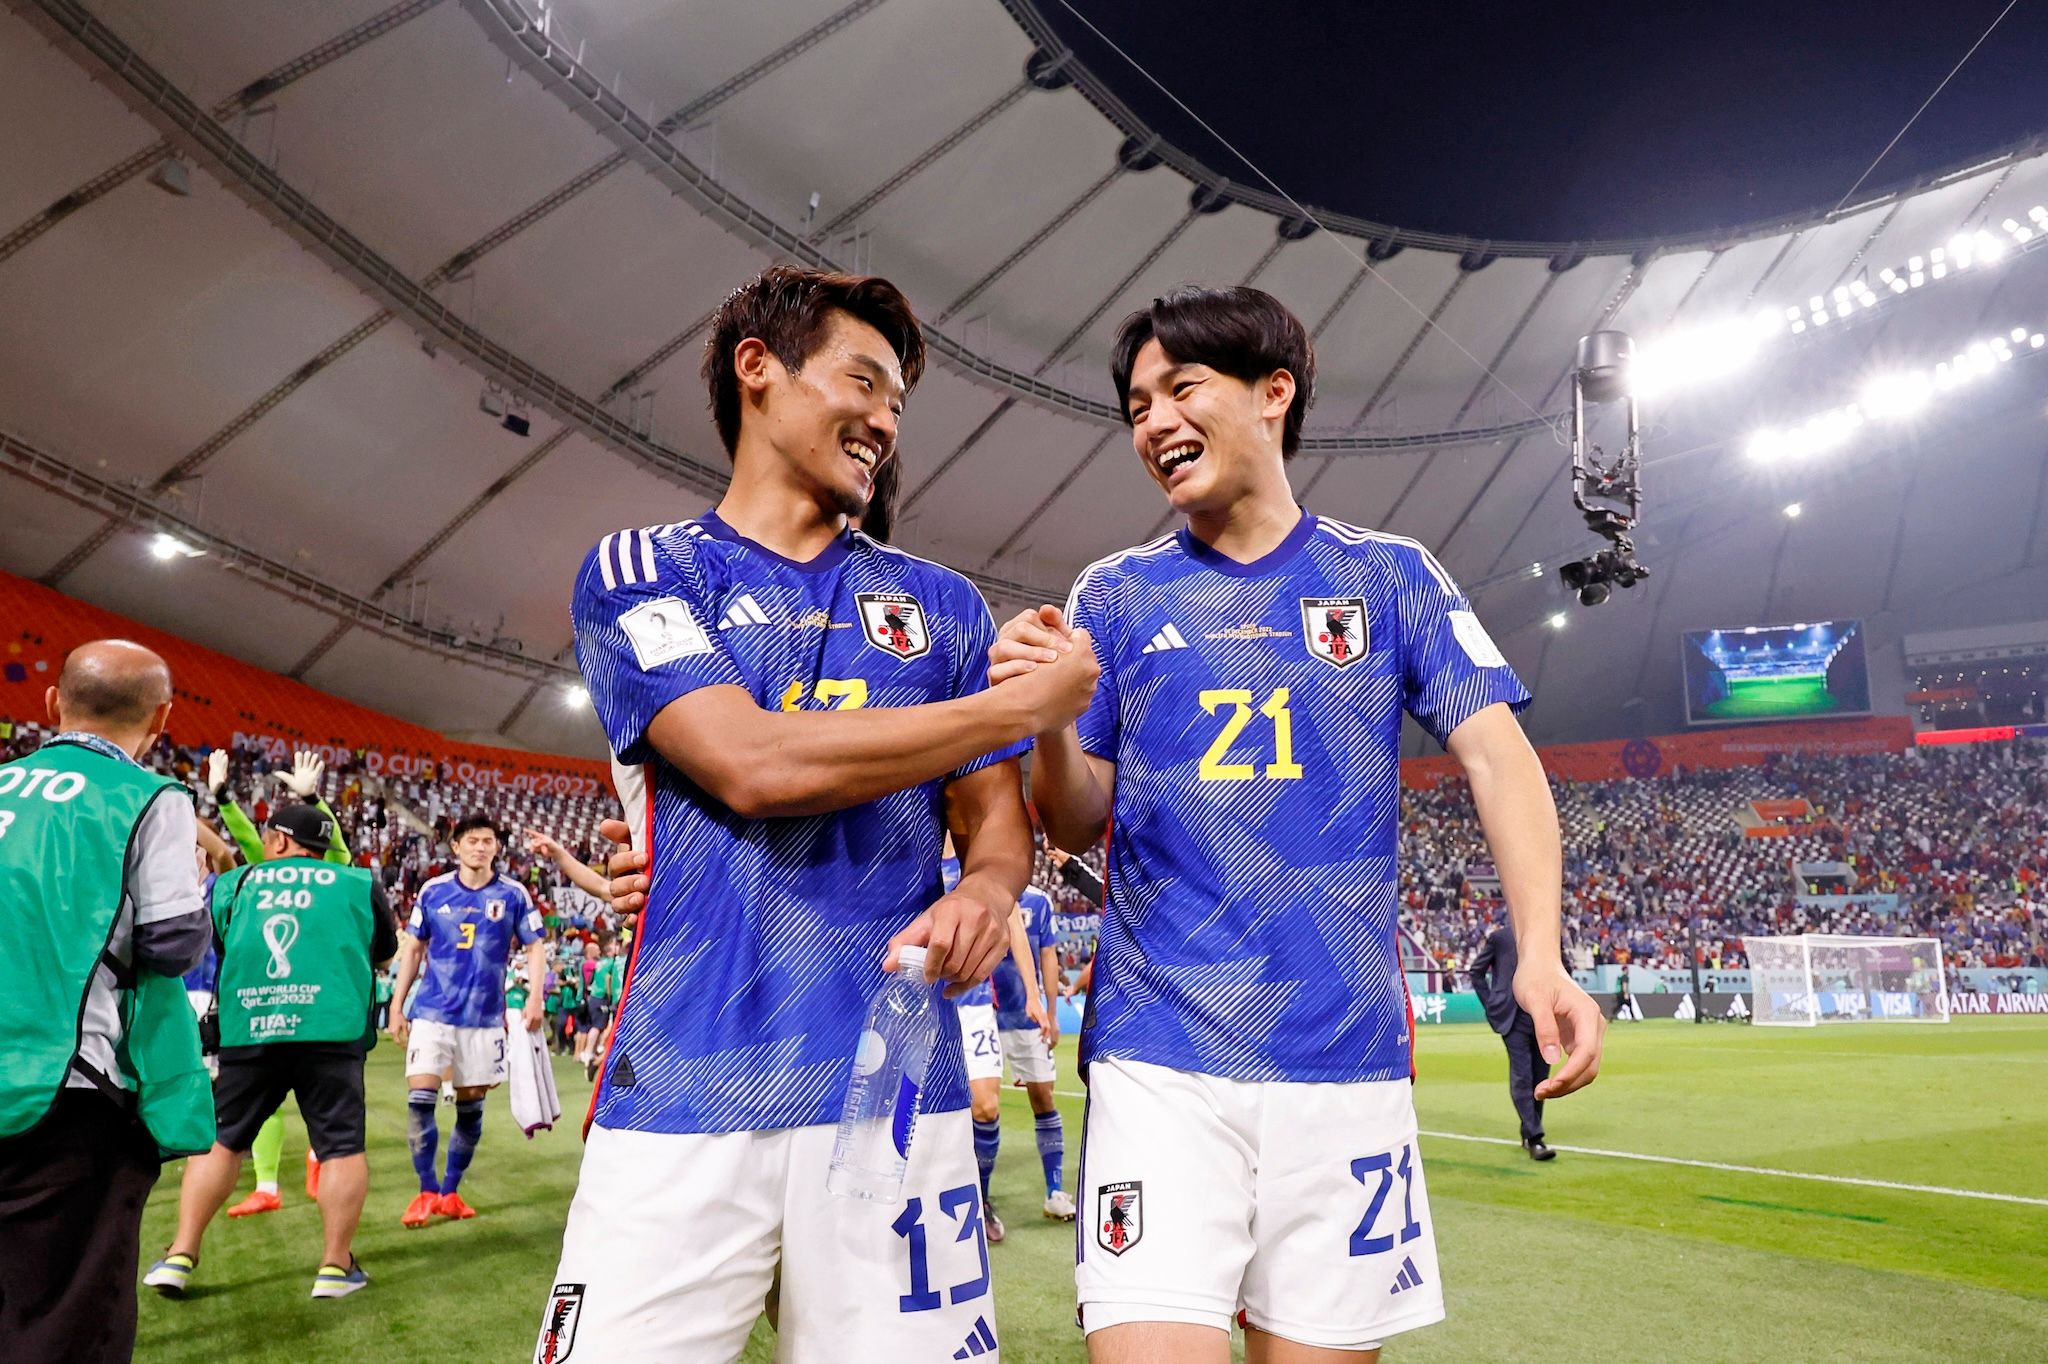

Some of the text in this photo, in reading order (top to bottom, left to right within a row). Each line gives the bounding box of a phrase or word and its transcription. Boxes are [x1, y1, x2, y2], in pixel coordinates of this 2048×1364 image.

[874, 595, 907, 603] JAPAN
[888, 636, 915, 649] JFA
[1326, 643, 1353, 656] JFA
[1198, 687, 1303, 781] 21
[292, 740, 384, 772] WORD
[256, 889, 311, 910] 240
[456, 922, 477, 949] 3
[237, 983, 321, 998] FIFA WORLD CUP
[1831, 992, 1868, 1015] VISA
[1878, 992, 1913, 1015] VISA
[1935, 992, 1992, 1014] QATAR
[494, 1039, 505, 1063] 3
[1106, 1182, 1132, 1193] JAPAN
[1349, 1143, 1422, 1258] 21
[891, 1183, 990, 1313] 13
[1107, 1231, 1130, 1245] JFA
